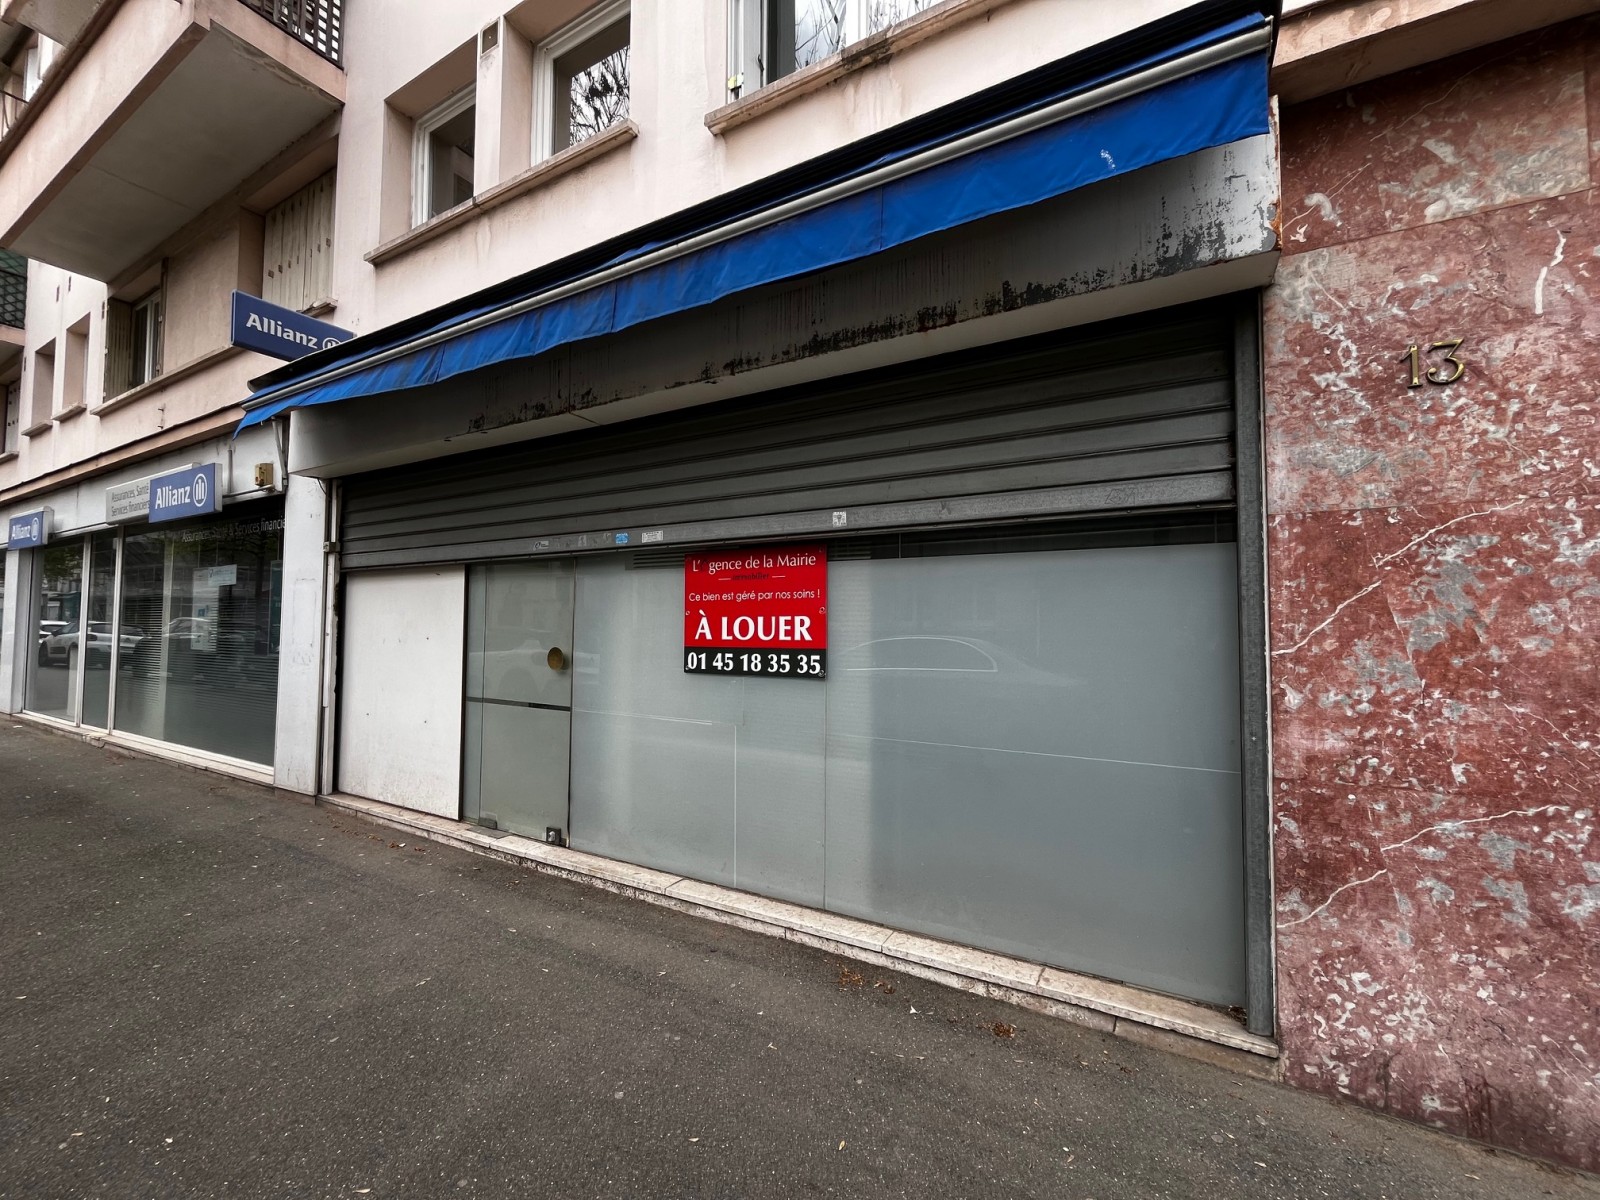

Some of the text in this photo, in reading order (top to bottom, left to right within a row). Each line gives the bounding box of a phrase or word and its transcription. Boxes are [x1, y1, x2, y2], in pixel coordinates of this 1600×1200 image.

[245, 312, 318, 349] Allianz
[1399, 337, 1464, 388] 13
[154, 485, 191, 510] Allianz
[745, 555, 760, 569] de
[763, 554, 773, 568] la
[777, 552, 816, 567] Mairie
[689, 592, 701, 602] Ce
[702, 591, 720, 601] bien
[722, 591, 734, 600] est
[736, 590, 755, 602] géré
[758, 591, 773, 601] par
[775, 592, 791, 600] nos
[793, 589, 815, 599] soins
[694, 609, 813, 641] À LOUER
[687, 652, 821, 675] 01 45 18 35 35
